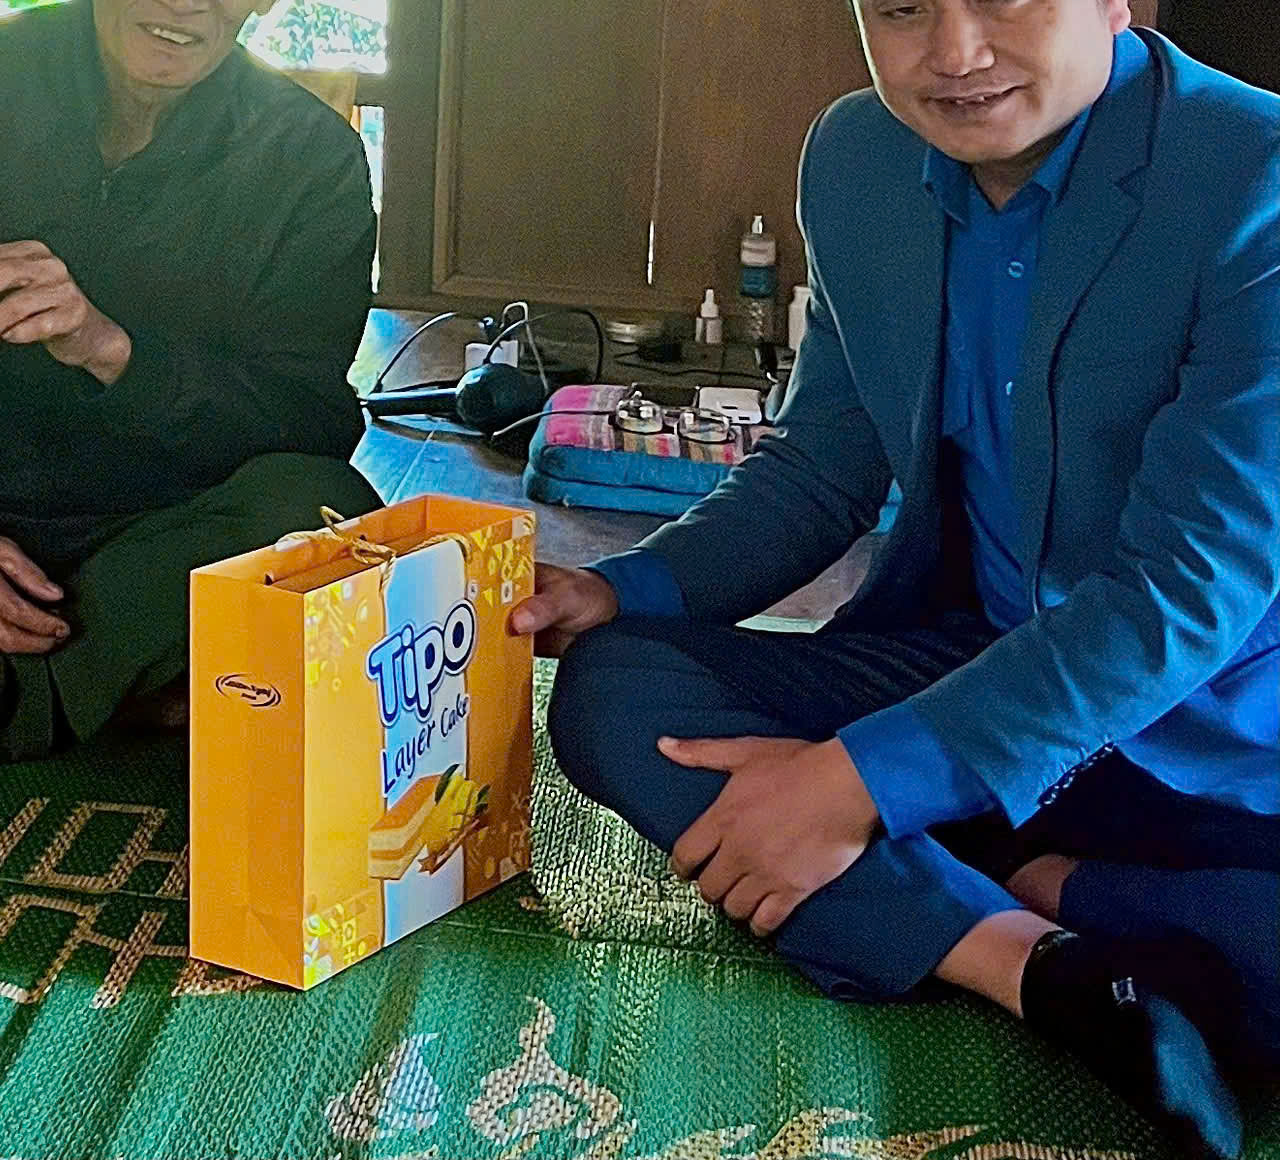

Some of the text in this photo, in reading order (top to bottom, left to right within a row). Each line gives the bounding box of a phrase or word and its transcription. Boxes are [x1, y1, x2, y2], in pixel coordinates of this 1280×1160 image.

[368, 602, 476, 724] Tipo
[381, 692, 469, 795] Layer Cake
